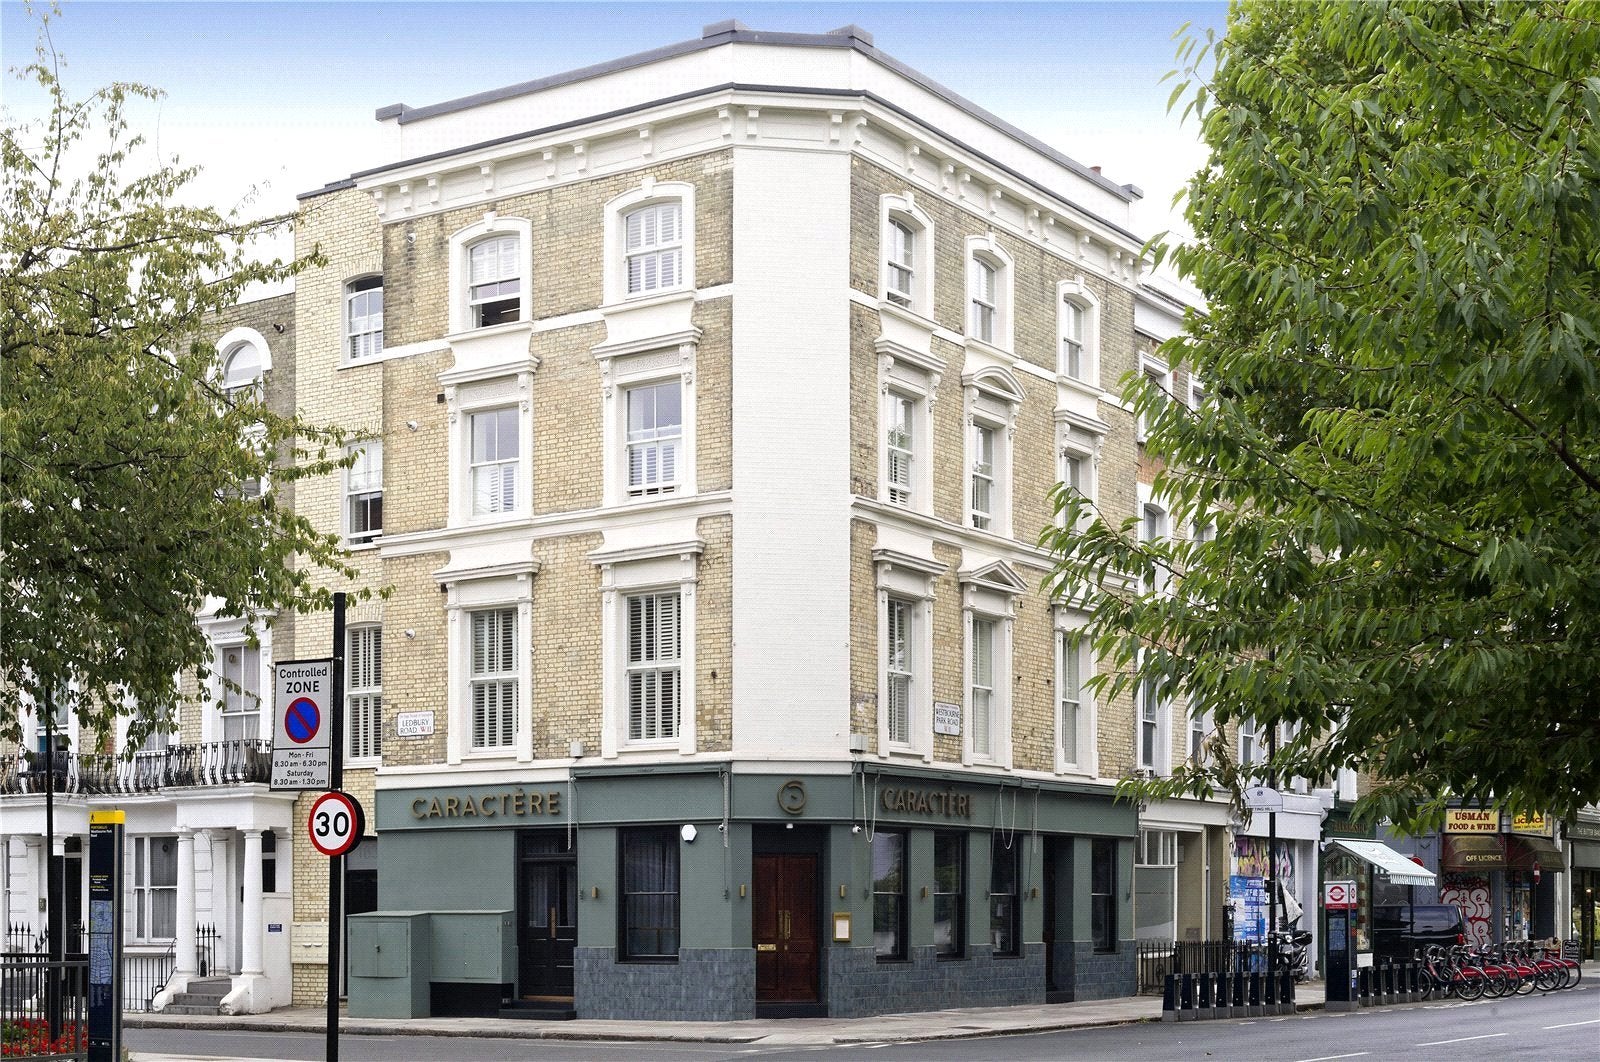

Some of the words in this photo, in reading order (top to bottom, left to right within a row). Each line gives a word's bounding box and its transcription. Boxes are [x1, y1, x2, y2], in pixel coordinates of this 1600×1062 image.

[280, 666, 327, 678] Controlled
[286, 681, 320, 693] ZONE
[936, 708, 960, 718] WESTBOURNE
[402, 719, 429, 727] LEDBURY
[936, 716, 947, 724] PARK
[947, 718, 959, 726] ROAD
[274, 760, 289, 768] 8.30
[287, 769, 314, 777] Saturday
[273, 778, 289, 786] 8.30
[411, 788, 560, 819] CARACTÈRE
[1455, 812, 1490, 820] USMAN
[315, 811, 350, 837] 30
[1465, 854, 1478, 862] OFF
[1478, 854, 1503, 862] LICENCE
